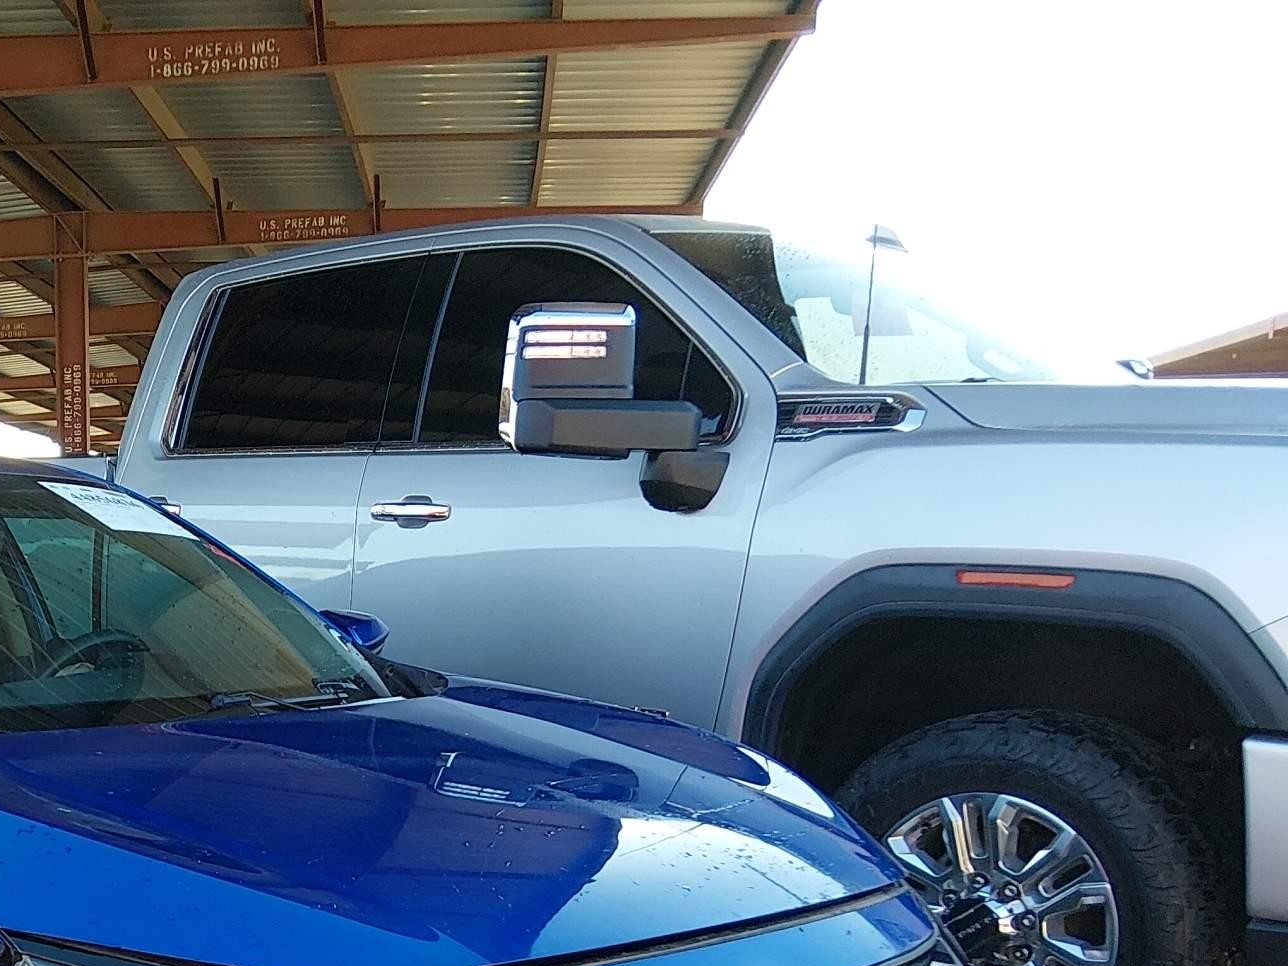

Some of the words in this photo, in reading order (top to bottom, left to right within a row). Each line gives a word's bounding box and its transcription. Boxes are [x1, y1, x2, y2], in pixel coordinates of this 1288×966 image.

[148, 46, 176, 62] U.S.
[185, 41, 243, 59] PREFAB
[251, 38, 280, 54] INC.
[150, 55, 280, 78] 1-866-799-0969
[259, 219, 280, 230] U.S.
[284, 216, 325, 229] PREFAB
[63, 388, 73, 428] PREFAB
[803, 404, 875, 416] DURAMAX
